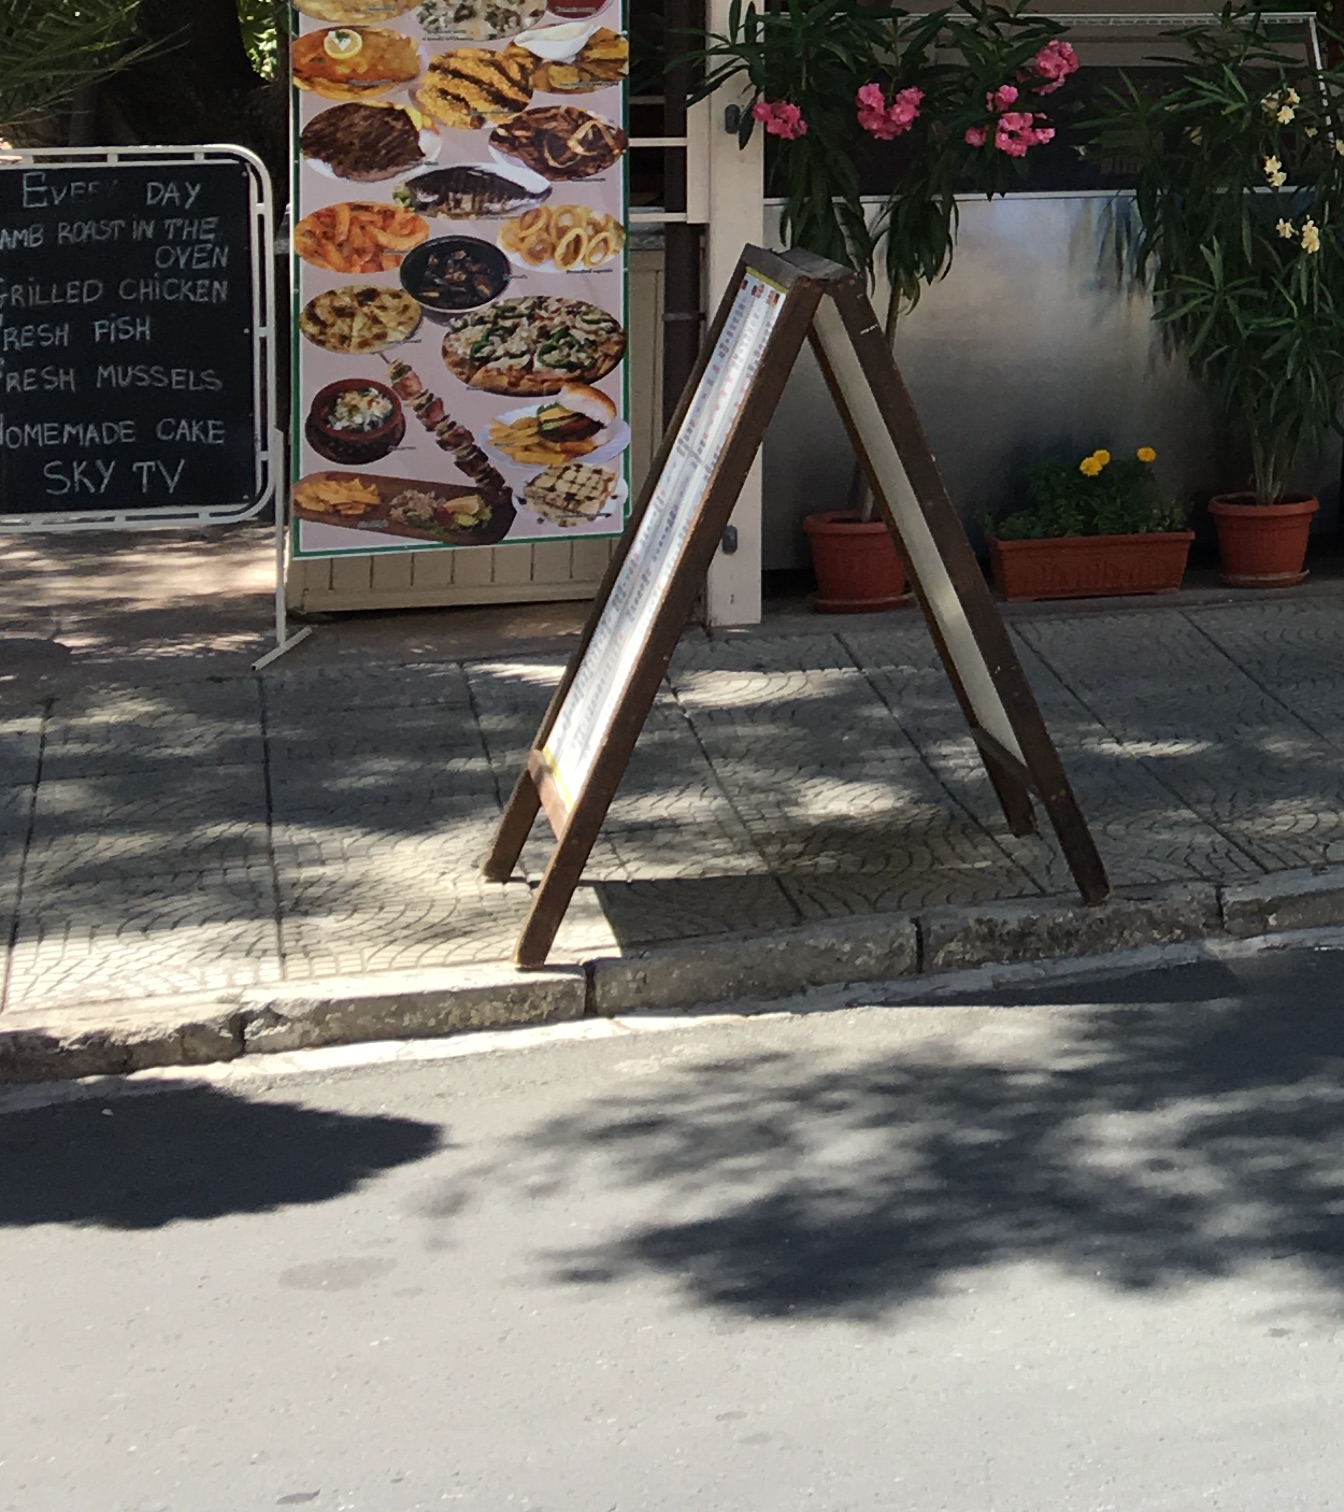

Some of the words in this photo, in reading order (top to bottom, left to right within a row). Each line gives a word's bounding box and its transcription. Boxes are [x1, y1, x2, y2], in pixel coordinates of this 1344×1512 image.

[146, 181, 201, 209] DAY
[0, 224, 44, 249] AMB
[57, 219, 126, 245] ROAST
[163, 216, 220, 240] THE
[155, 244, 228, 269] OVEN
[0, 313, 69, 351] RESH
[96, 365, 224, 391] MUSSELS
[156, 418, 226, 444] CAKE
[43, 458, 116, 495] SKY
[132, 458, 186, 494] TV
